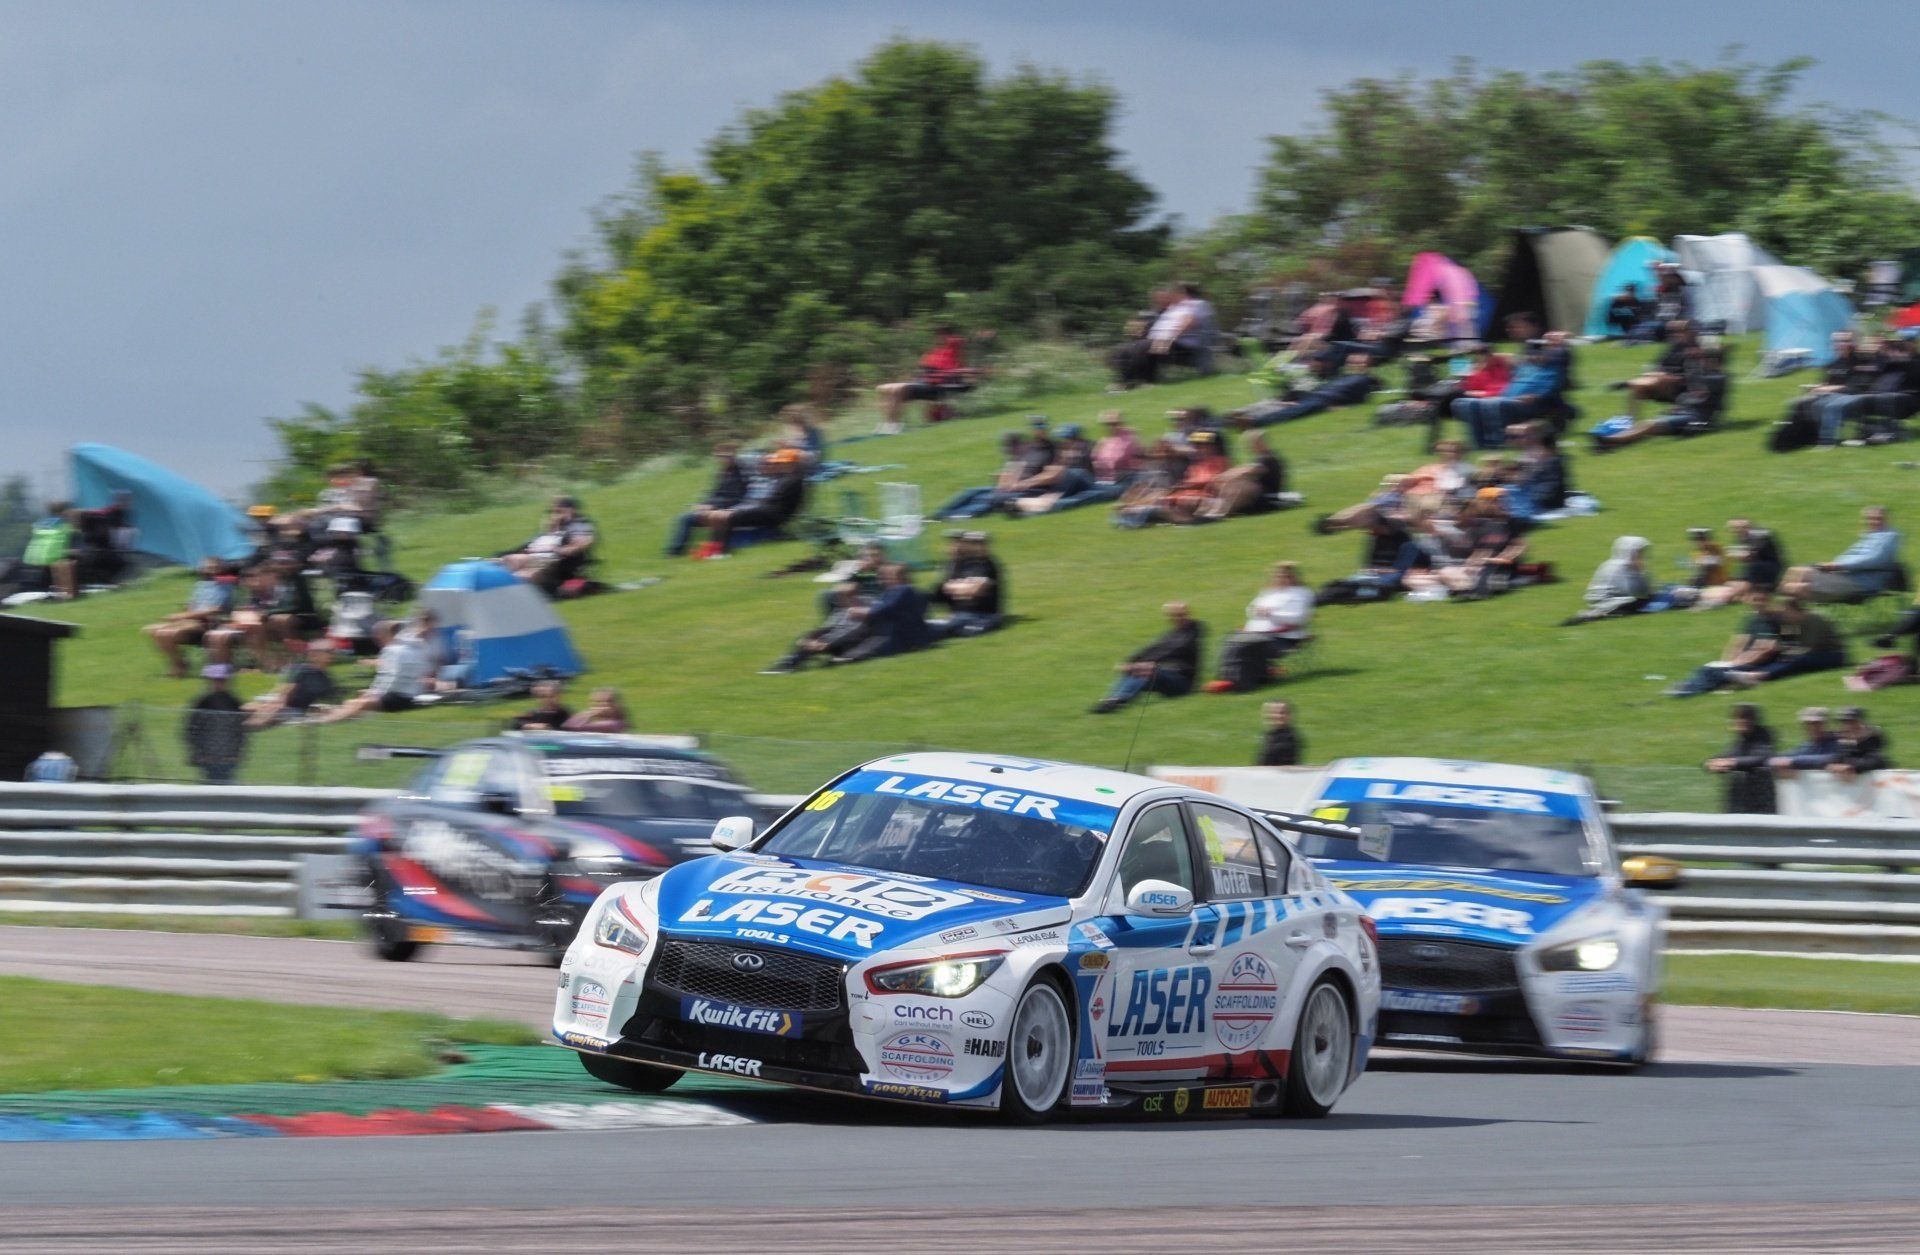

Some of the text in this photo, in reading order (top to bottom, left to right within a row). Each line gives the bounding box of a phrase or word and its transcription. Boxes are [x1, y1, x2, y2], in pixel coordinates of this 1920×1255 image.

[804, 790, 846, 811] 16
[874, 775, 1060, 820] LASER
[1140, 892, 1178, 906] LASER
[678, 899, 885, 949] LASER
[734, 927, 790, 944] TOOLS
[1107, 966, 1212, 1037] LASER
[1214, 995, 1277, 1010] SCAFFOLDING
[894, 1004, 953, 1022] cinch
[966, 1015, 990, 1026] HEL
[1136, 1040, 1165, 1056] TOOLS
[698, 1052, 763, 1077] LASER
[881, 1051, 955, 1066] SCAFFOLDING
[872, 1084, 942, 1099] GOODYEAR
[1143, 1093, 1165, 1112] ast
